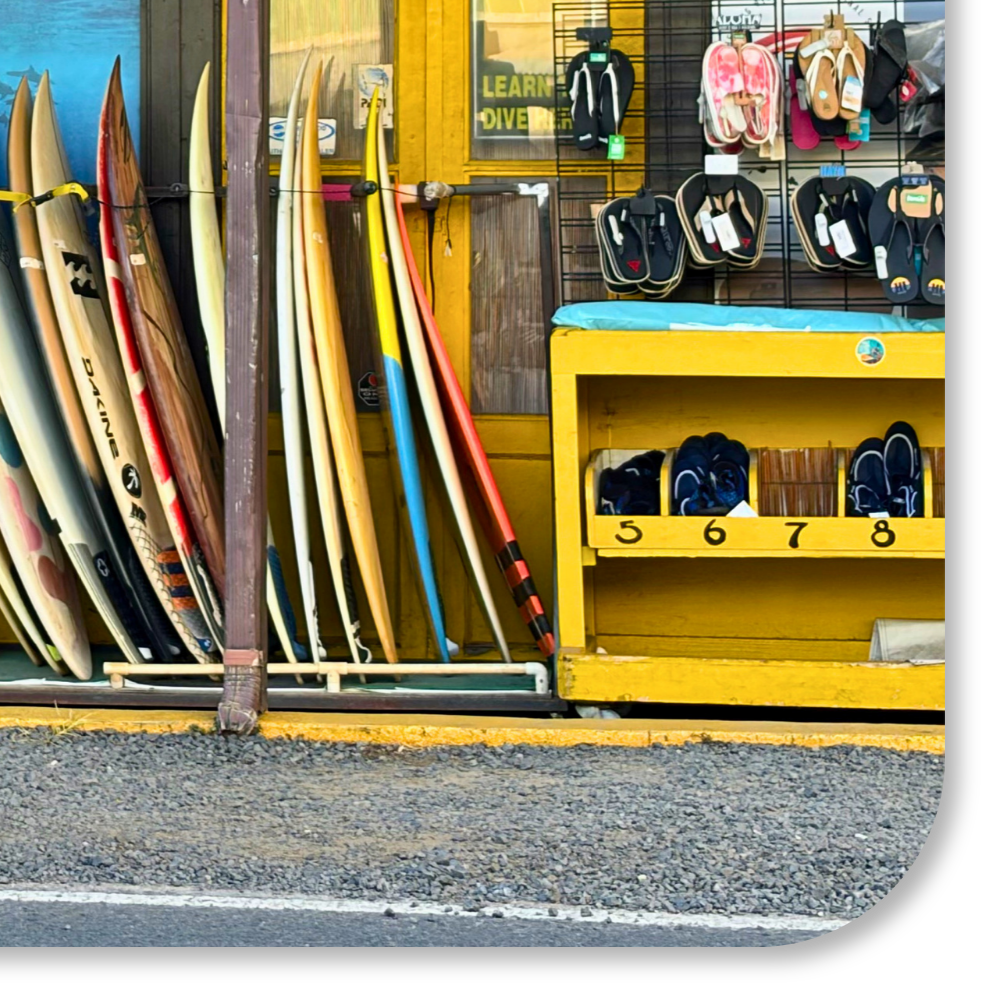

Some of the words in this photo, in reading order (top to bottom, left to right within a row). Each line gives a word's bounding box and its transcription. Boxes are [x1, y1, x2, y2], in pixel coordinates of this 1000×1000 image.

[482, 75, 551, 98] LEARN
[482, 107, 528, 130] DIVE
[532, 107, 573, 130] HER
[81, 356, 119, 460] DAKINE
[615, 520, 643, 544] 5
[703, 518, 726, 546] 6
[784, 521, 808, 548] 7
[870, 519, 896, 548] 8
